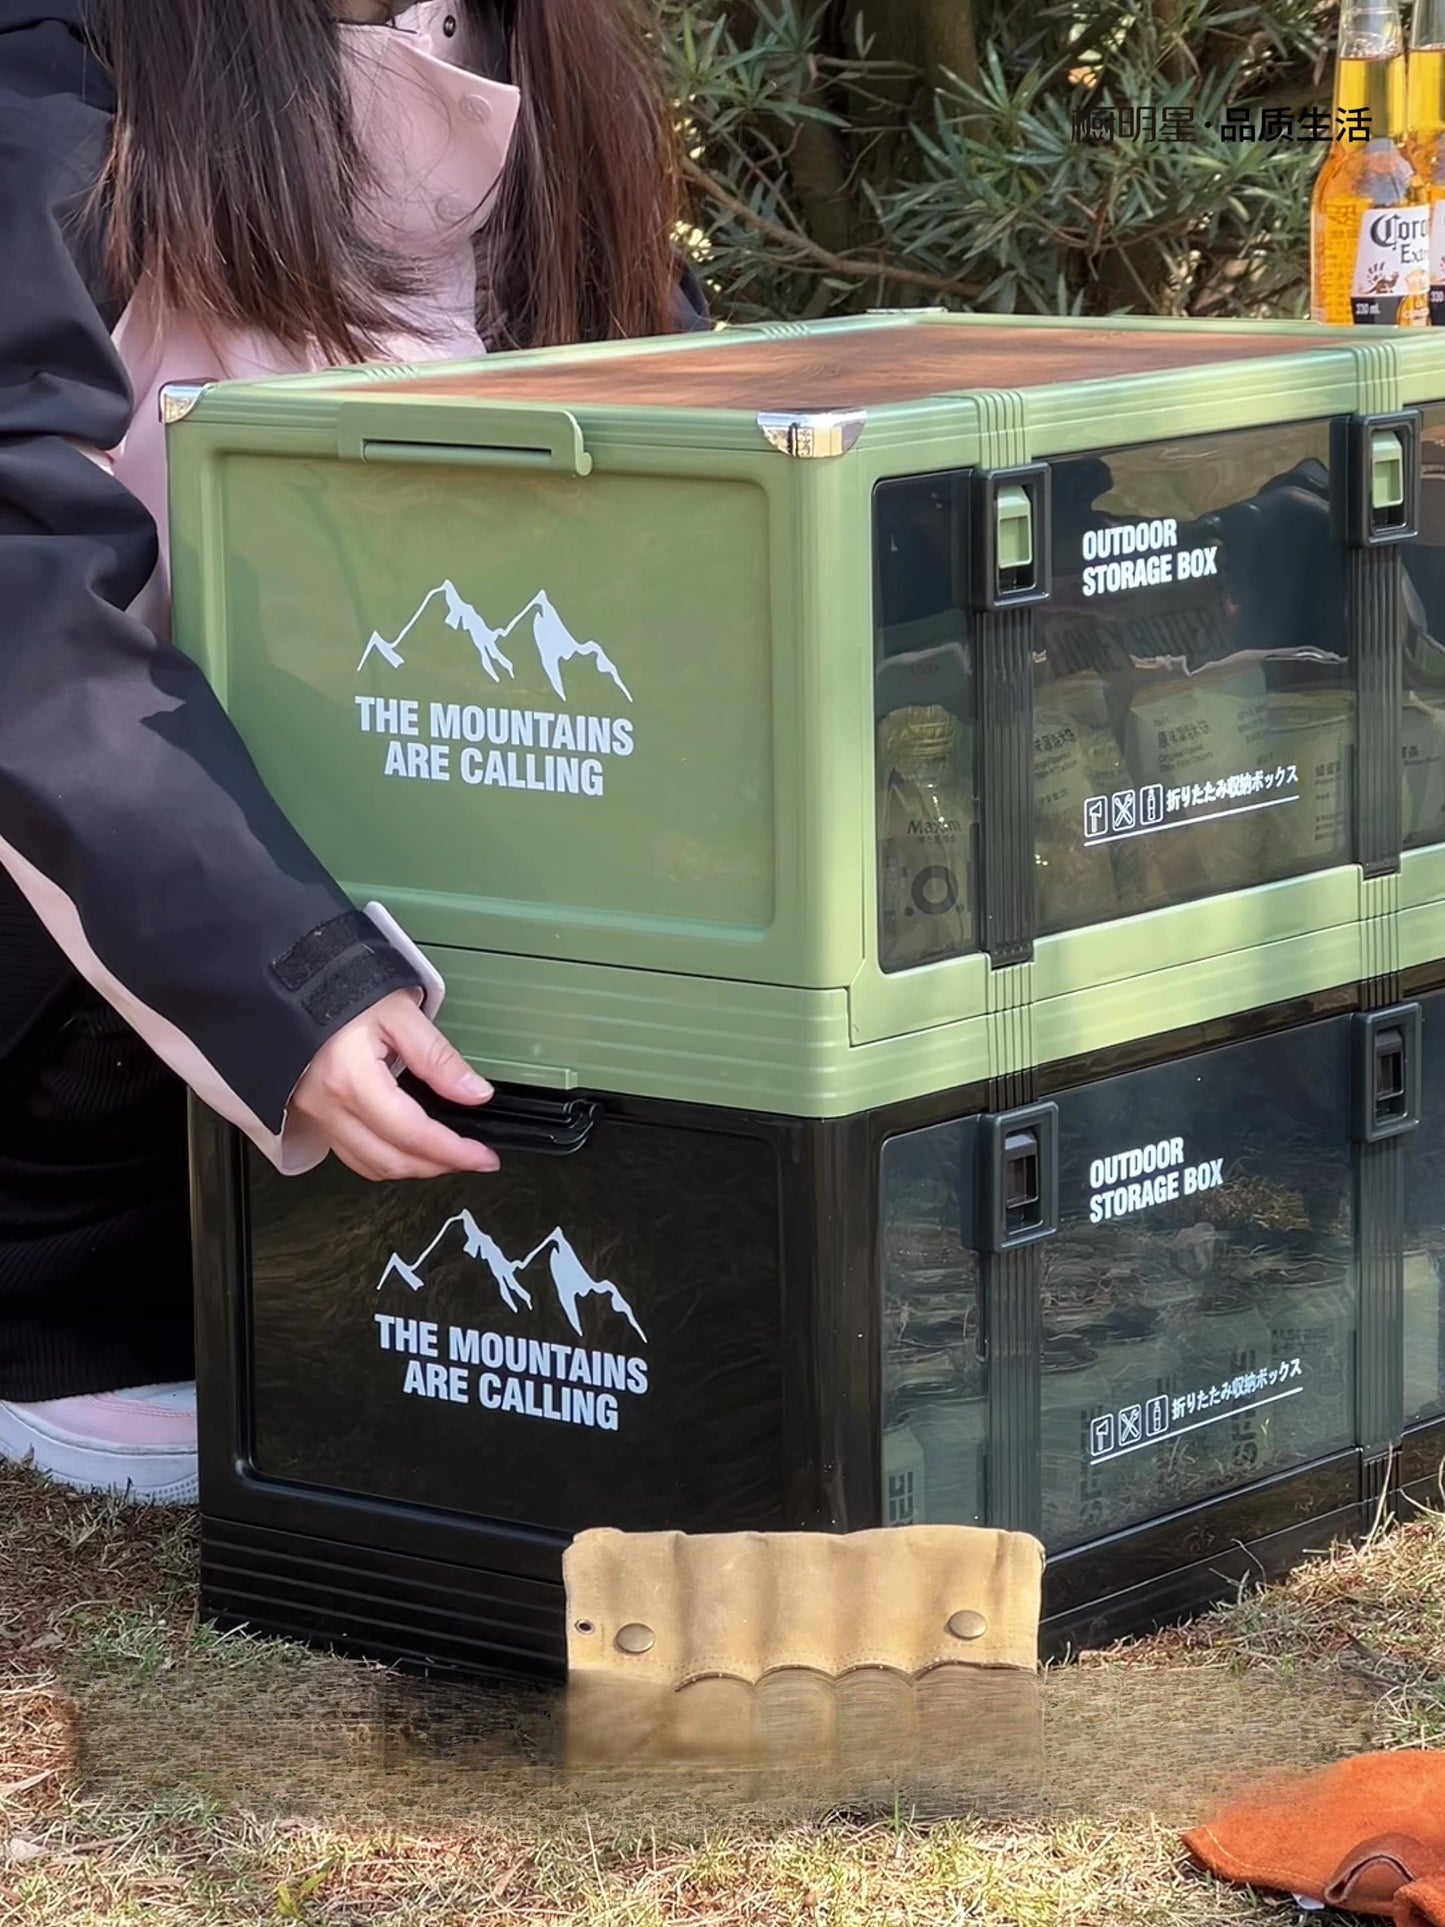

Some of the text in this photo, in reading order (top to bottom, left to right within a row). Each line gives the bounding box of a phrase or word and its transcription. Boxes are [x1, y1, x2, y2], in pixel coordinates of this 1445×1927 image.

[1082, 518, 1178, 561] OUTDOOR
[1082, 546, 1218, 597] STORAGE BOX
[354, 695, 635, 757] THE MOUNTAINS
[384, 740, 604, 797] ARE CALLING
[1165, 764, 1299, 813] 折りたたみ収納ボックス
[1089, 1136, 1185, 1190] OUTDOOR
[1089, 1157, 1225, 1224] STORAGE BOX
[374, 1313, 649, 1395] THE MOUNTAINS
[402, 1359, 619, 1432] ARE CALLING
[1171, 1357, 1303, 1421] 折りたたみ収納ボックス
